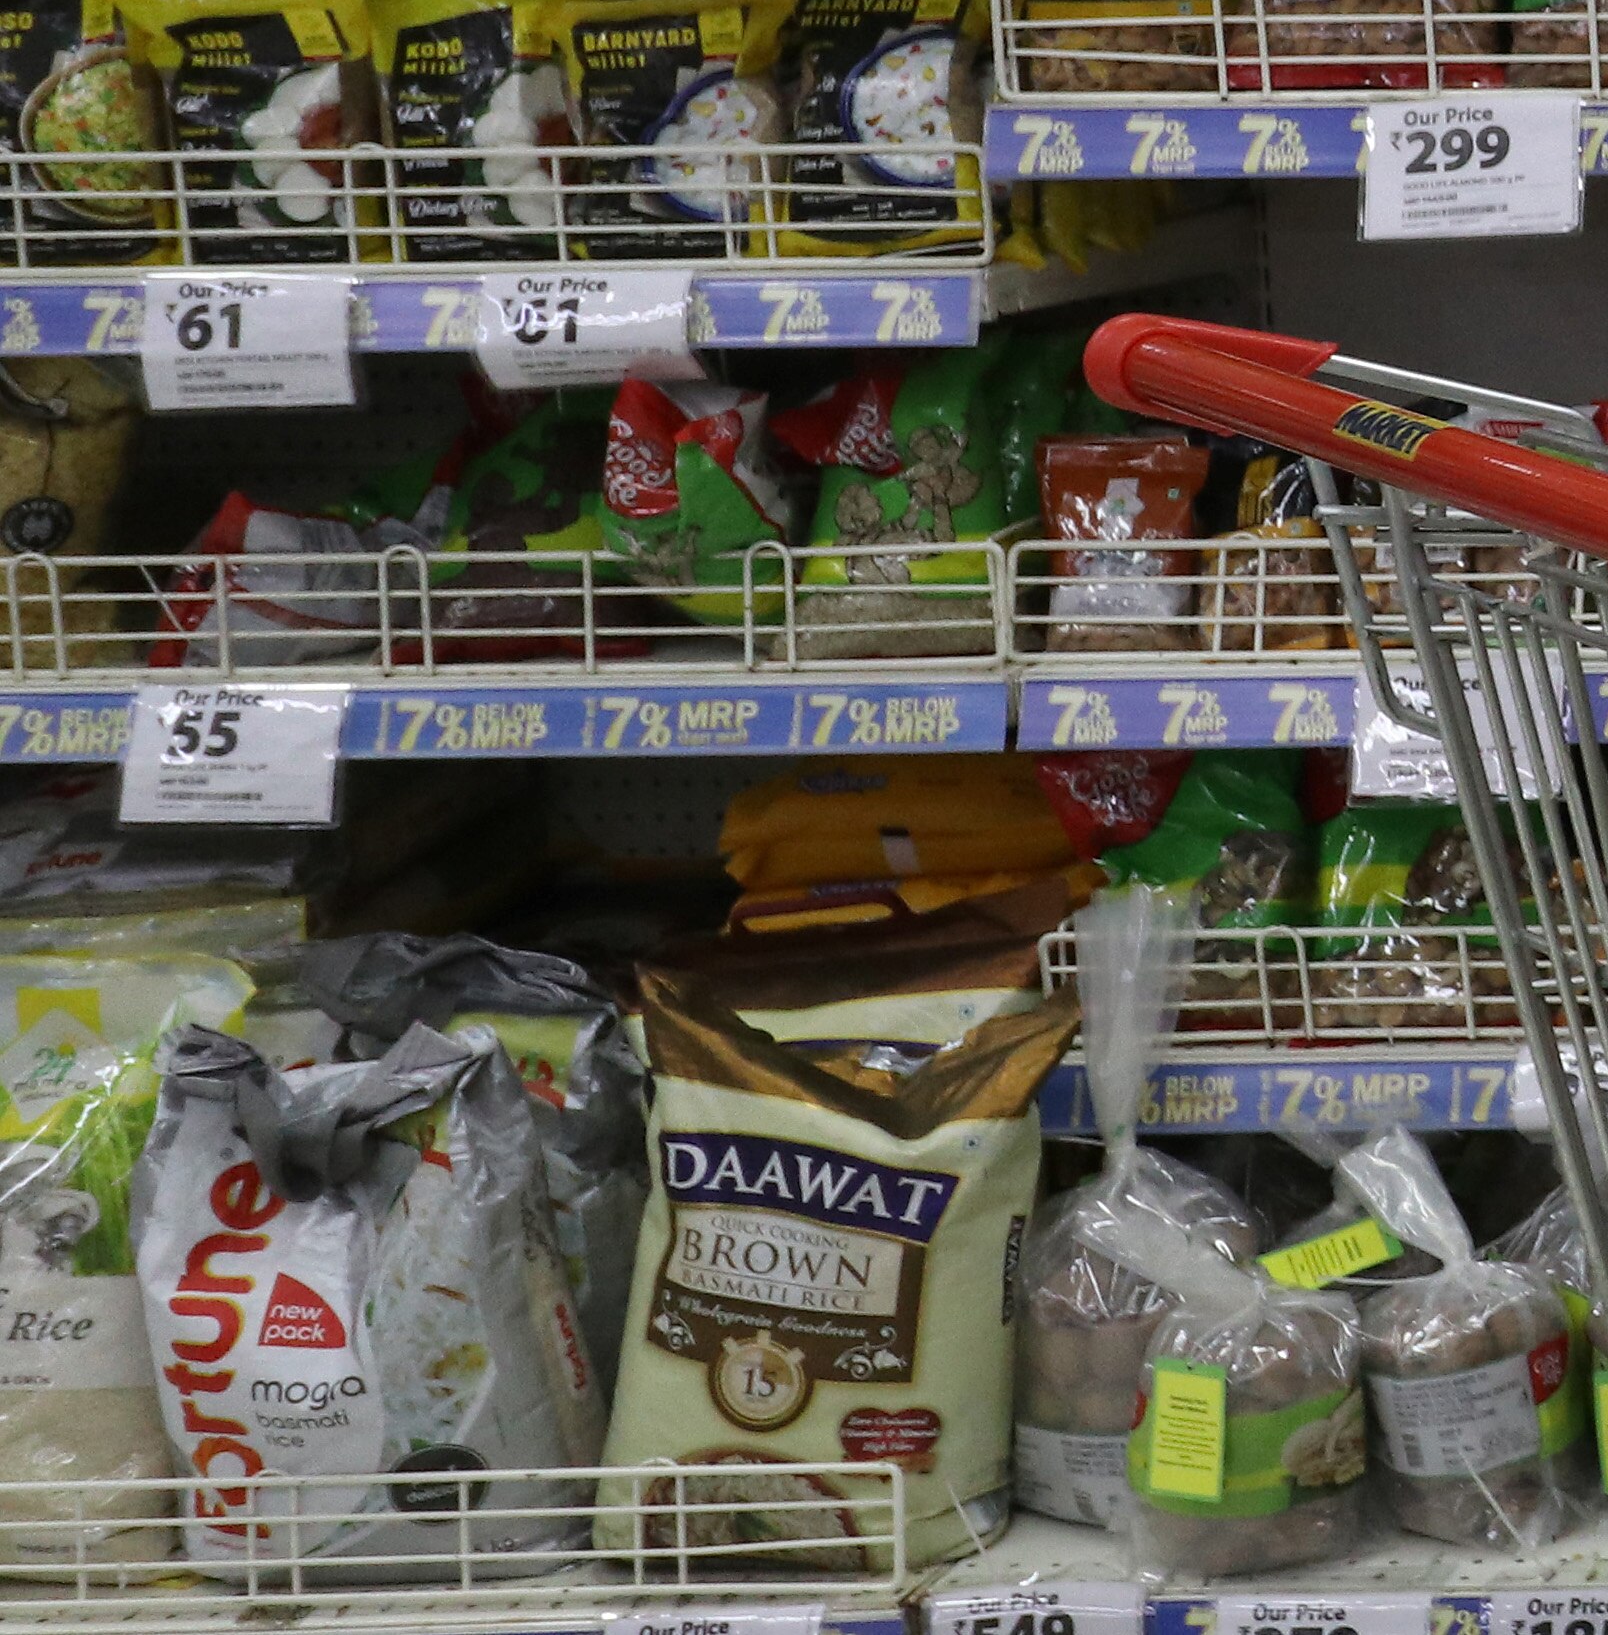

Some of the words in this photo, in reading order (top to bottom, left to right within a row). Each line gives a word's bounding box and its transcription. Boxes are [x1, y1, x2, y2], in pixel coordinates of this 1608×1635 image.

[582, 26, 698, 52] BARNYARD
[1403, 108, 1437, 126] Our
[1445, 105, 1493, 123] Price
[179, 283, 213, 298] Our
[220, 283, 269, 297] Price
[517, 276, 554, 294] Our
[562, 277, 608, 293] Price
[174, 688, 210, 706] Our
[216, 688, 265, 706] Price
[664, 1140, 945, 1226] DAAWAT
[682, 1228, 873, 1289] BROWN
[680, 1271, 788, 1301] BASMATI
[800, 1288, 866, 1310] RICE
[269, 1304, 323, 1321] new
[8, 1311, 94, 1342] Rice
[264, 1322, 326, 1345] pack
[250, 1375, 367, 1412] mogra
[254, 1411, 350, 1431] basmati
[264, 1432, 306, 1449] rice
[1528, 1598, 1566, 1615] Our
